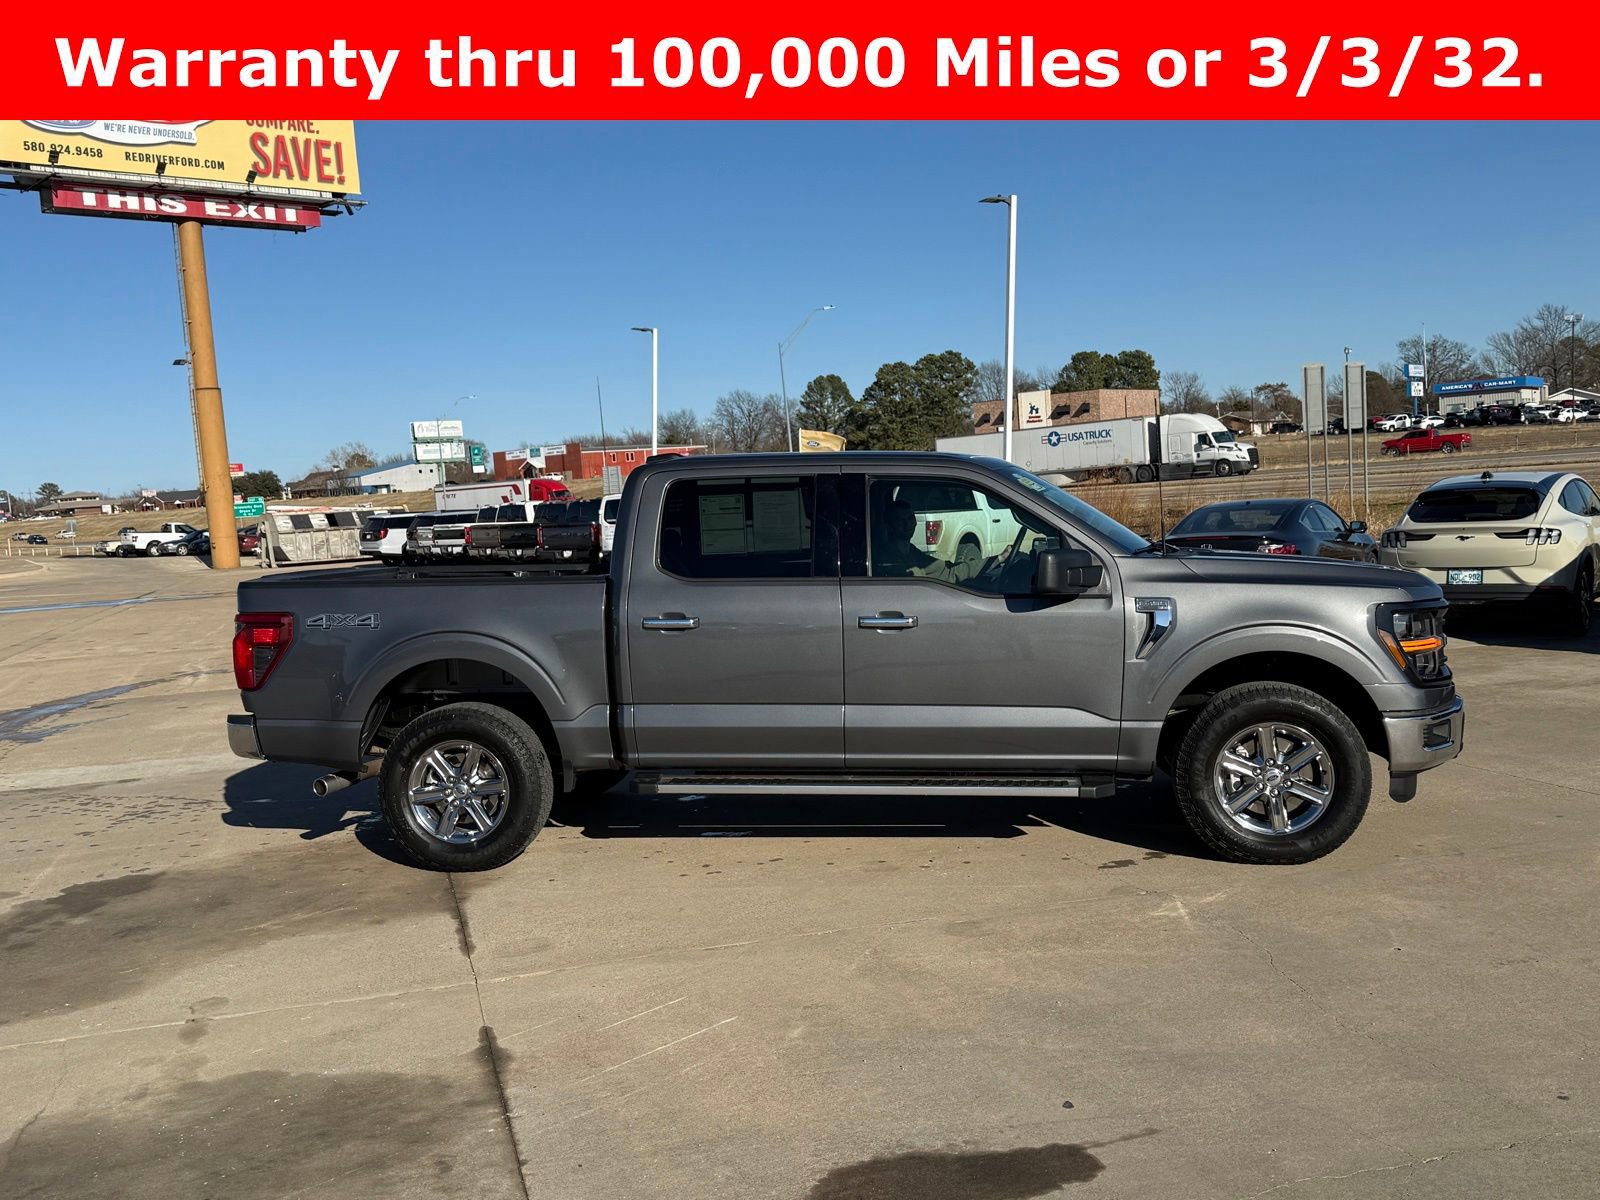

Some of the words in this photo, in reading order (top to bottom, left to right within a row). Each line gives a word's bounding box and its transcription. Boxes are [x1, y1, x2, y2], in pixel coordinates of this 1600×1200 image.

[103, 122, 126, 133] WE'RE
[128, 124, 151, 136] NEVER
[153, 127, 195, 141] UNDERSOLD.
[23, 140, 104, 158] 580.924.9458
[250, 131, 346, 184] SAVE!
[125, 151, 225, 171] REDRIVERFORD.COM
[74, 188, 188, 214] THIS
[204, 198, 303, 223] EXIT
